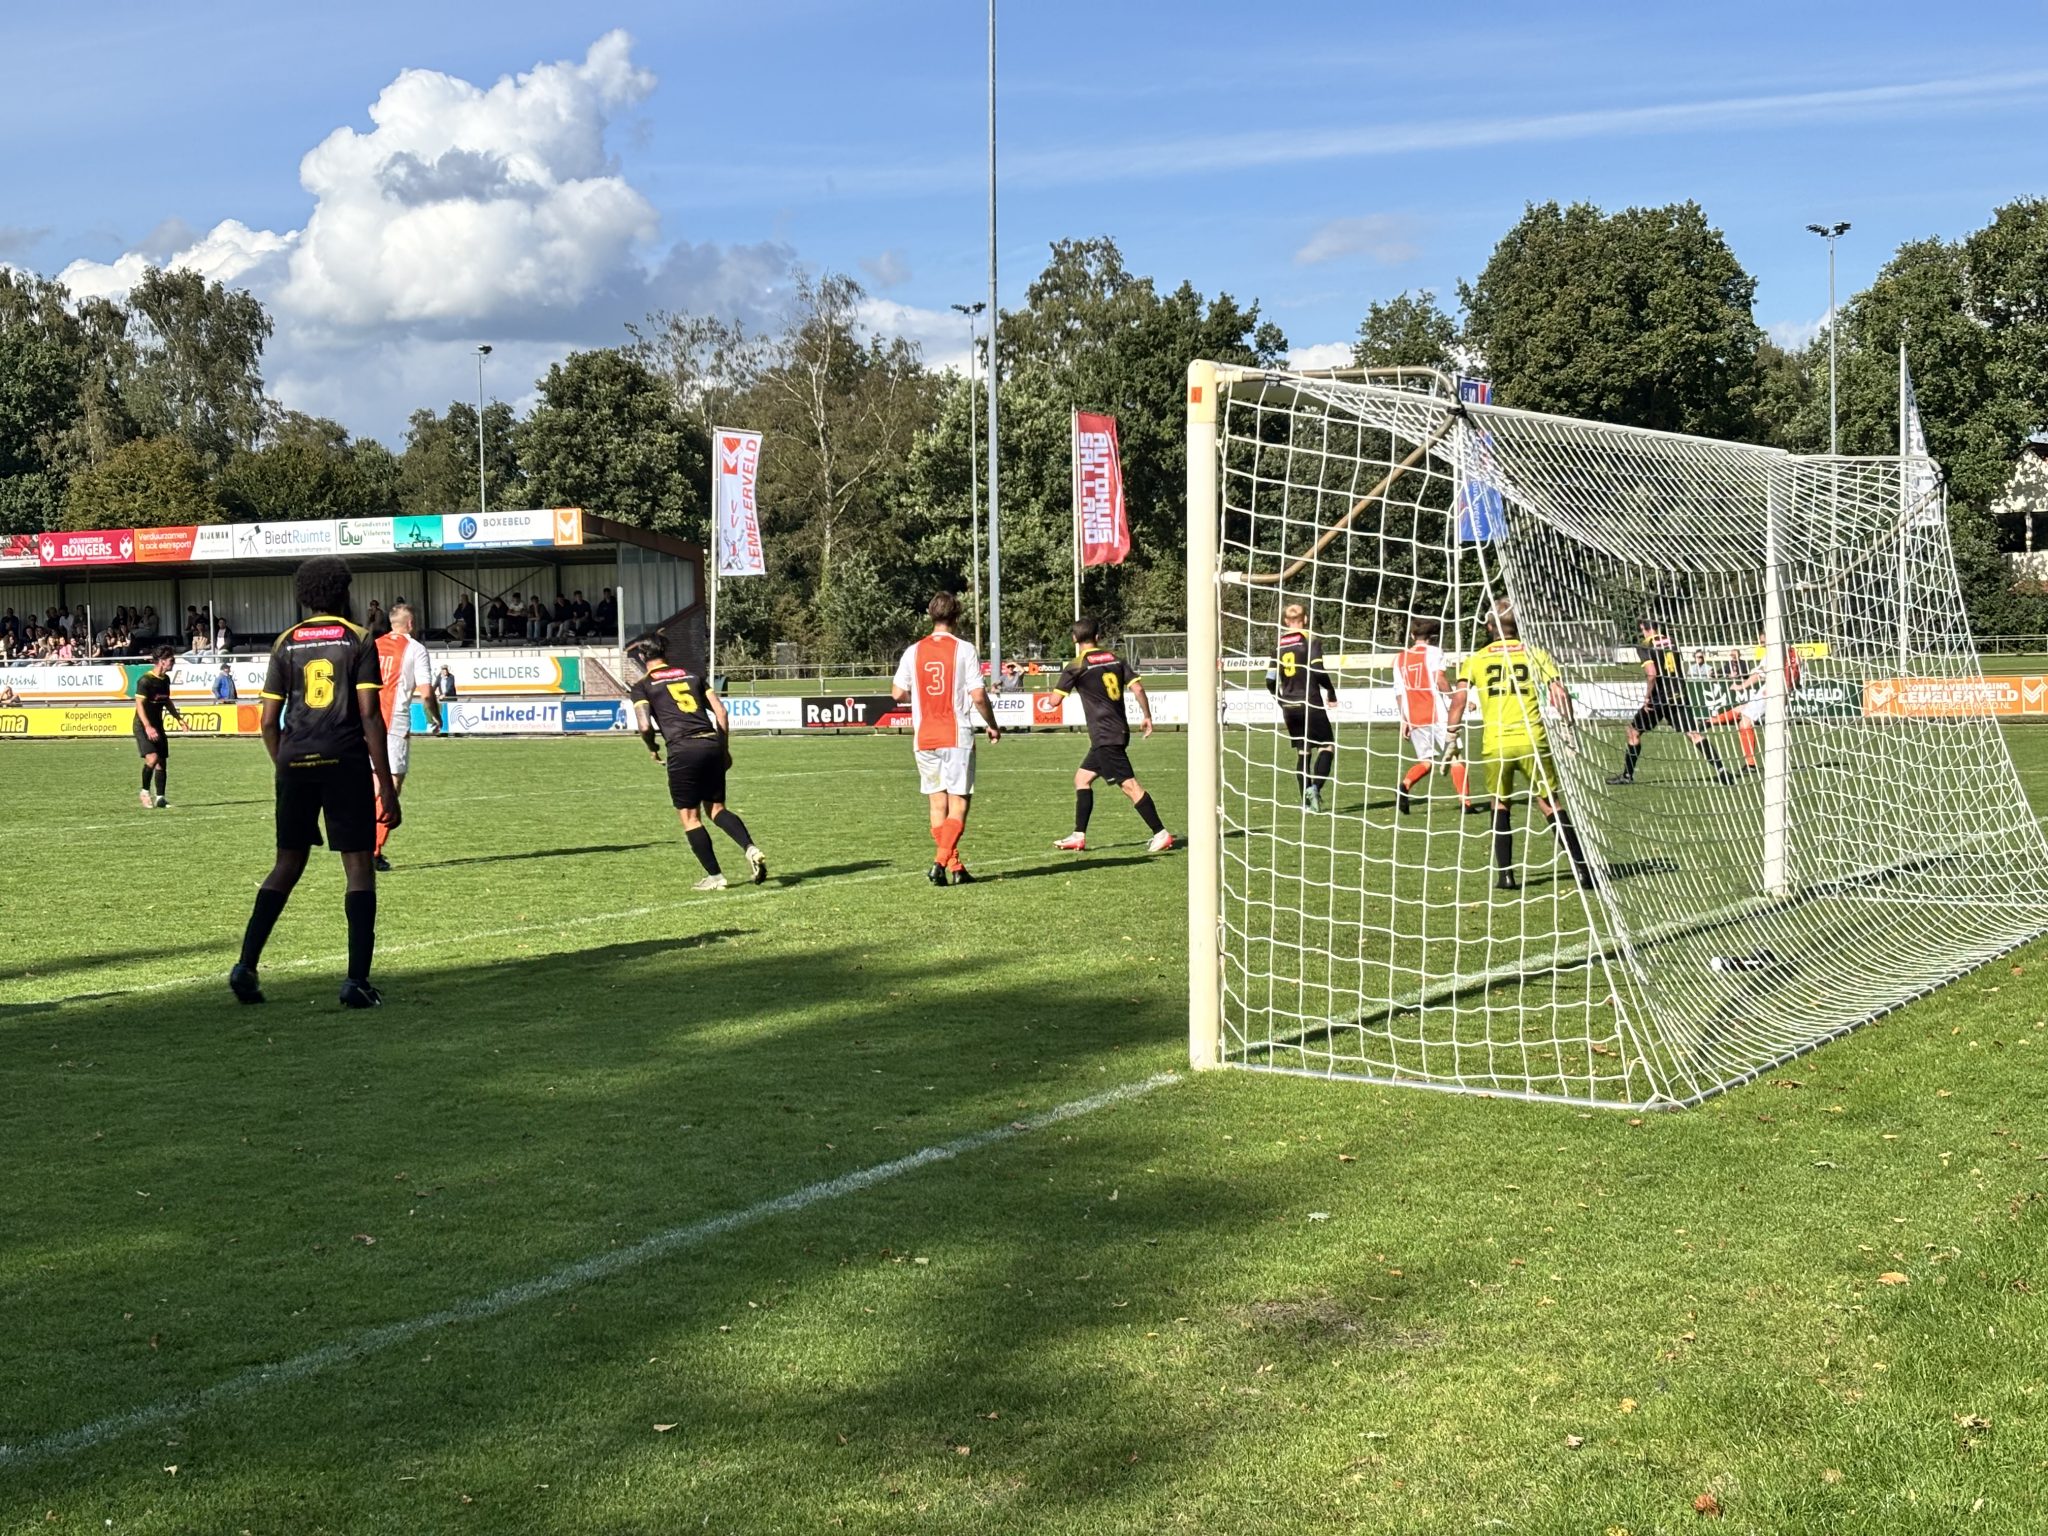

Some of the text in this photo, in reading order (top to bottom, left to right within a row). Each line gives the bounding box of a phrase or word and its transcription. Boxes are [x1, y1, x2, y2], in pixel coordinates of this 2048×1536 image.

[1079, 432, 1100, 545] SALLAND
[1092, 432, 1113, 543] AUTOHUIS
[742, 438, 762, 569] LEMELERVELD
[483, 517, 531, 527] BOXEBELD
[265, 529, 332, 545] BiedtRuimte
[61, 542, 113, 557] BONGERS
[1226, 659, 1265, 668] tielbeke
[57, 674, 104, 687] ISOLATIE
[473, 666, 540, 679] SCHILDERS
[924, 661, 945, 696] 3
[1486, 663, 1530, 696] 22
[304, 658, 335, 709] 6
[1101, 671, 1121, 702] 8
[666, 681, 698, 714] 5
[990, 700, 1024, 709] VEERD
[1897, 689, 2019, 704] LEMELERVELD
[481, 705, 559, 721] Linked-IT
[724, 699, 761, 716] DERS
[806, 702, 867, 723] ReDIT
[1222, 701, 1275, 711] ootsma
[65, 711, 112, 721] Koppelingen
[162, 712, 221, 732] ekoma
[60, 723, 118, 733] Cilinderkoppen
